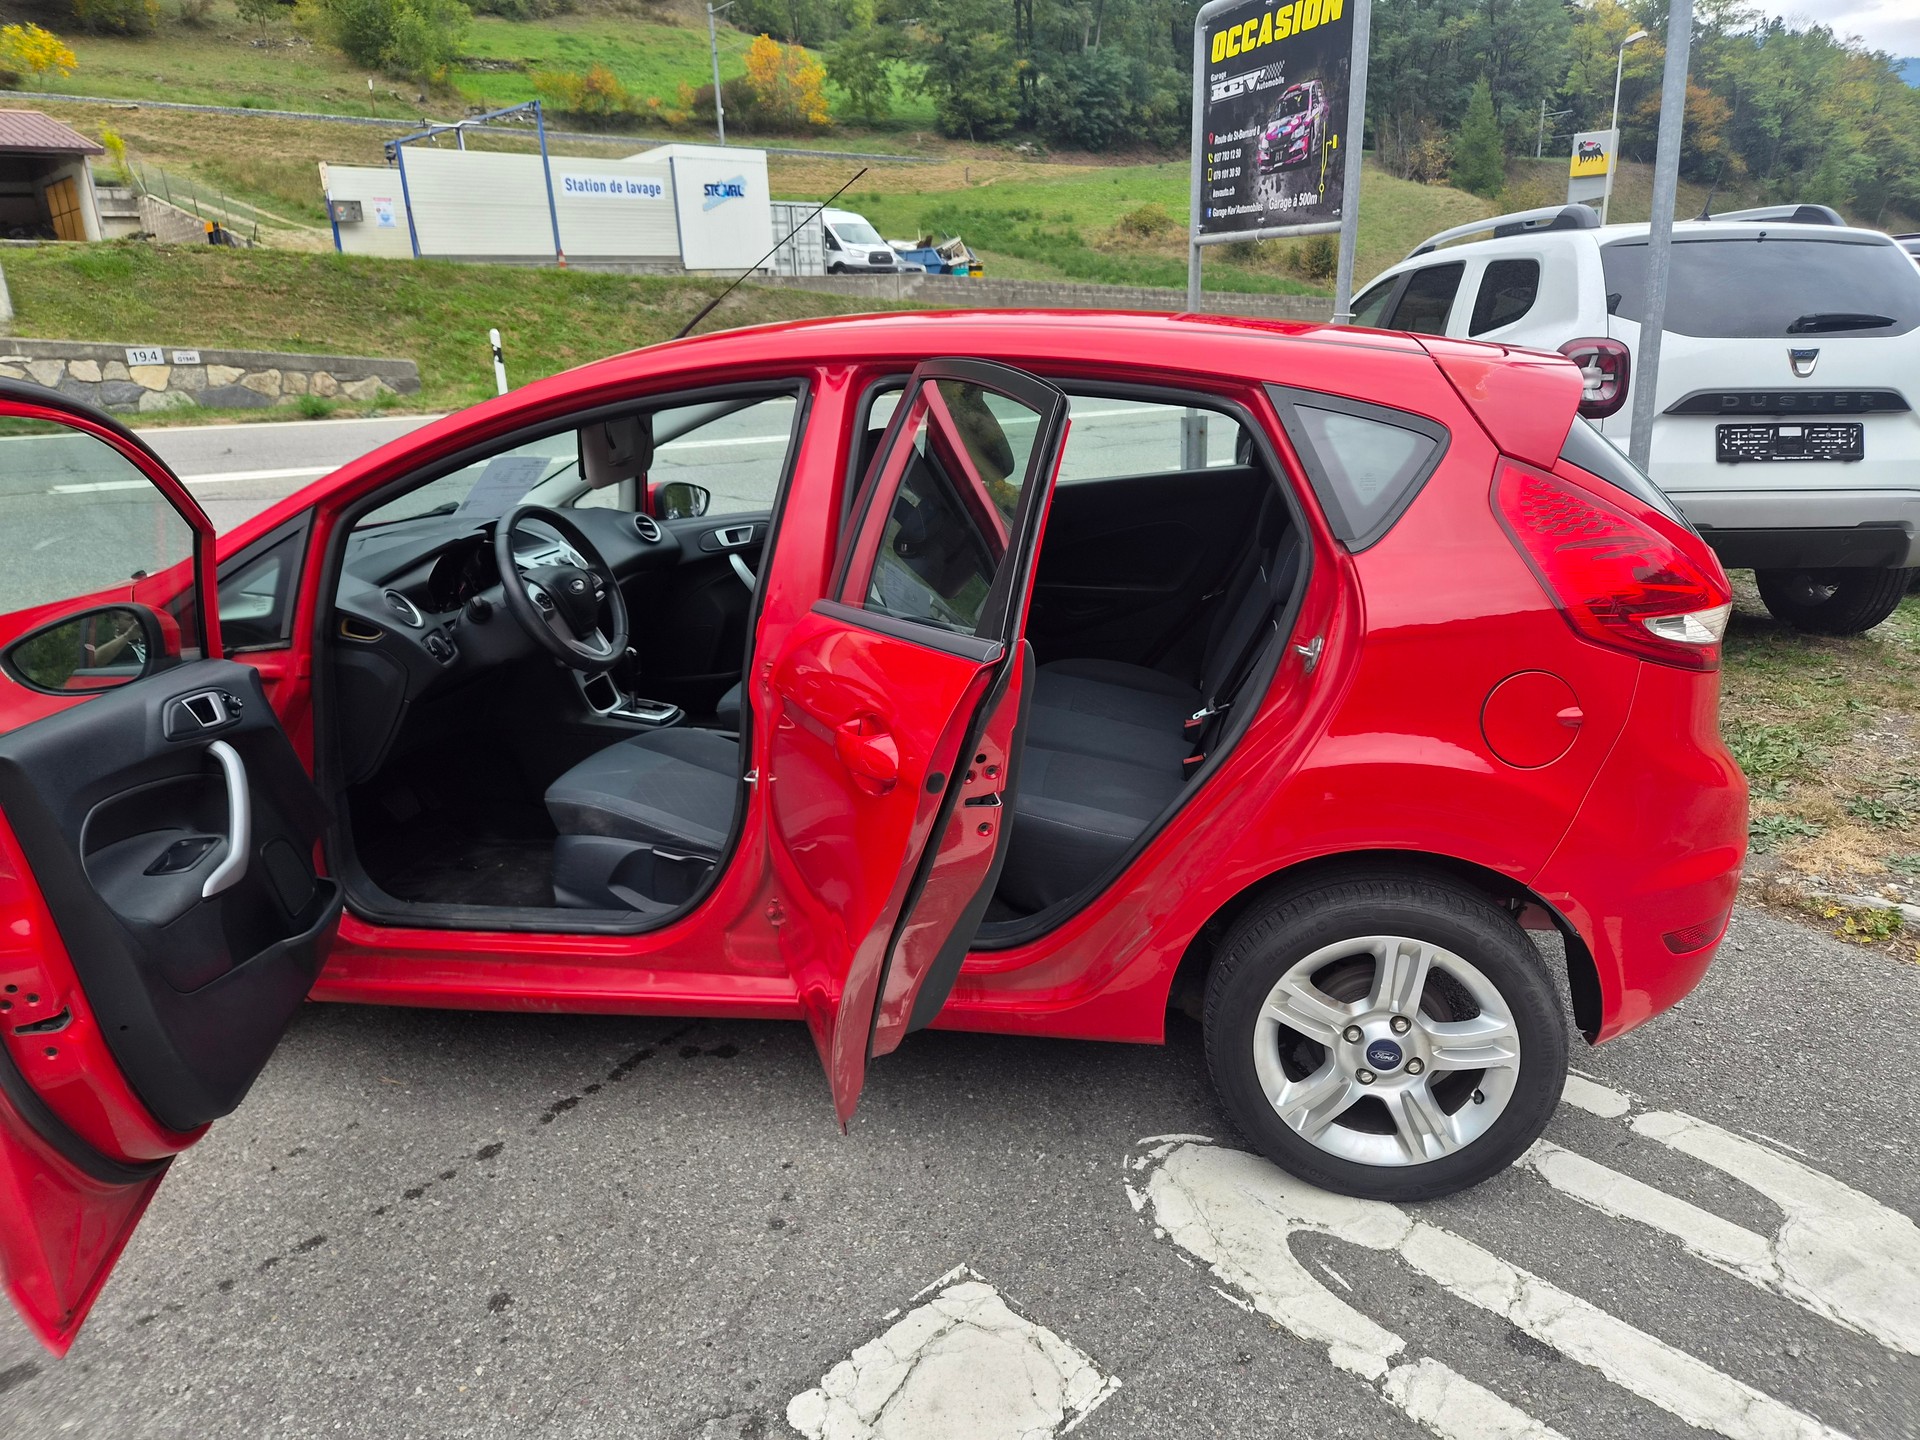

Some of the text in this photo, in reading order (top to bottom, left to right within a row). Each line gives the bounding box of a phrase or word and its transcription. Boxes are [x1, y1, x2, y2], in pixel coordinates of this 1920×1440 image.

[1211, 0, 1344, 63] OCCASION
[1211, 71, 1227, 82] Garage
[1256, 76, 1285, 91] Automobile
[1230, 149, 1235, 160] 12
[564, 178, 662, 197] Station de lavage
[1268, 192, 1318, 211] Garage à 500m
[1212, 208, 1227, 218] Garage
[133, 351, 157, 362] 19.4
[1721, 395, 1875, 407] DUSTER
[1374, 1052, 1395, 1061] Ford
